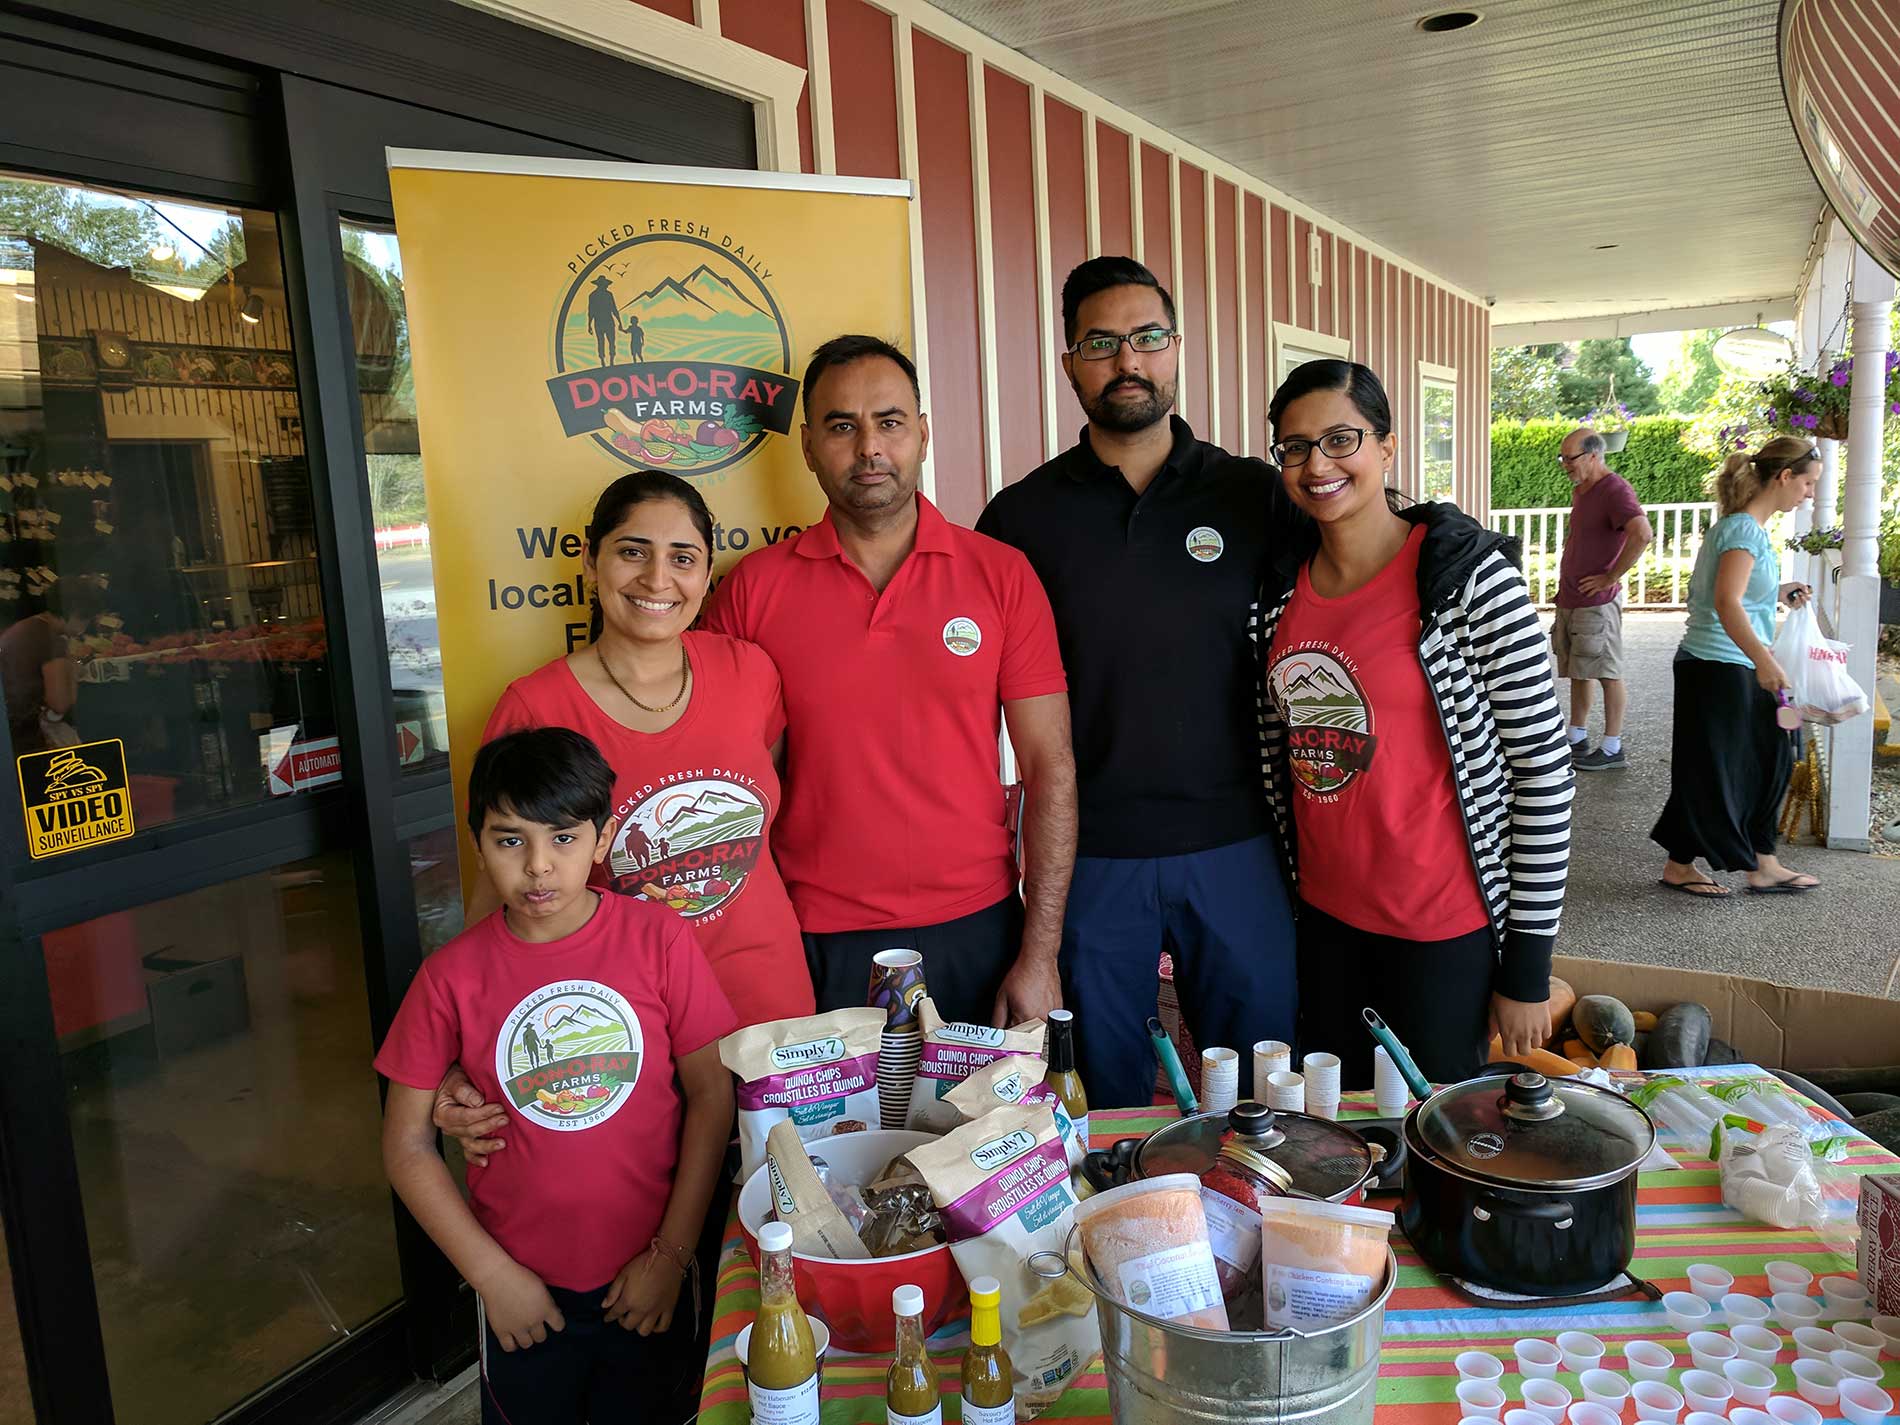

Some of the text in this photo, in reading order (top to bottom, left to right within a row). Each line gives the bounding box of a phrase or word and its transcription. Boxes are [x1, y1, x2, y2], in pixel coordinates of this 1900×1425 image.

[567, 219, 773, 282] PICKED FRESH DAILY
[567, 368, 784, 409] DON-O-RAY
[635, 401, 723, 417] FARMS
[713, 522, 749, 551] to
[1299, 641, 1330, 650] FRESH
[1332, 645, 1359, 673] DAILY
[1293, 749, 1334, 760] FARMS
[49, 790, 69, 801] SPY
[85, 783, 104, 794] SPY
[614, 768, 757, 821] ICKED FRESH DAILY
[1318, 794, 1339, 804] 1960
[35, 793, 122, 833] VIDEO
[39, 818, 125, 850] SURVEILLANCE
[662, 865, 722, 886] FARMS
[695, 909, 723, 928] 1960
[511, 985, 620, 1025] PICKED FRESH DAILY
[937, 1049, 994, 1066] QUINOA CHIPS
[516, 1056, 632, 1095] DON-O-RAY
[552, 1073, 600, 1091] FARMS
[763, 1075, 865, 1104] CROUSTILLES DE QUINOA
[785, 1067, 842, 1090] QUINOA CHIPS
[559, 1111, 606, 1127] EST 1960
[998, 1169, 1027, 1192] QUINOA
[1025, 1153, 1047, 1175] CHIPS
[987, 1158, 1069, 1219] CROUSTILLES DE QUINOA
[1867, 1195, 1879, 1295] CHERRY JUICE
